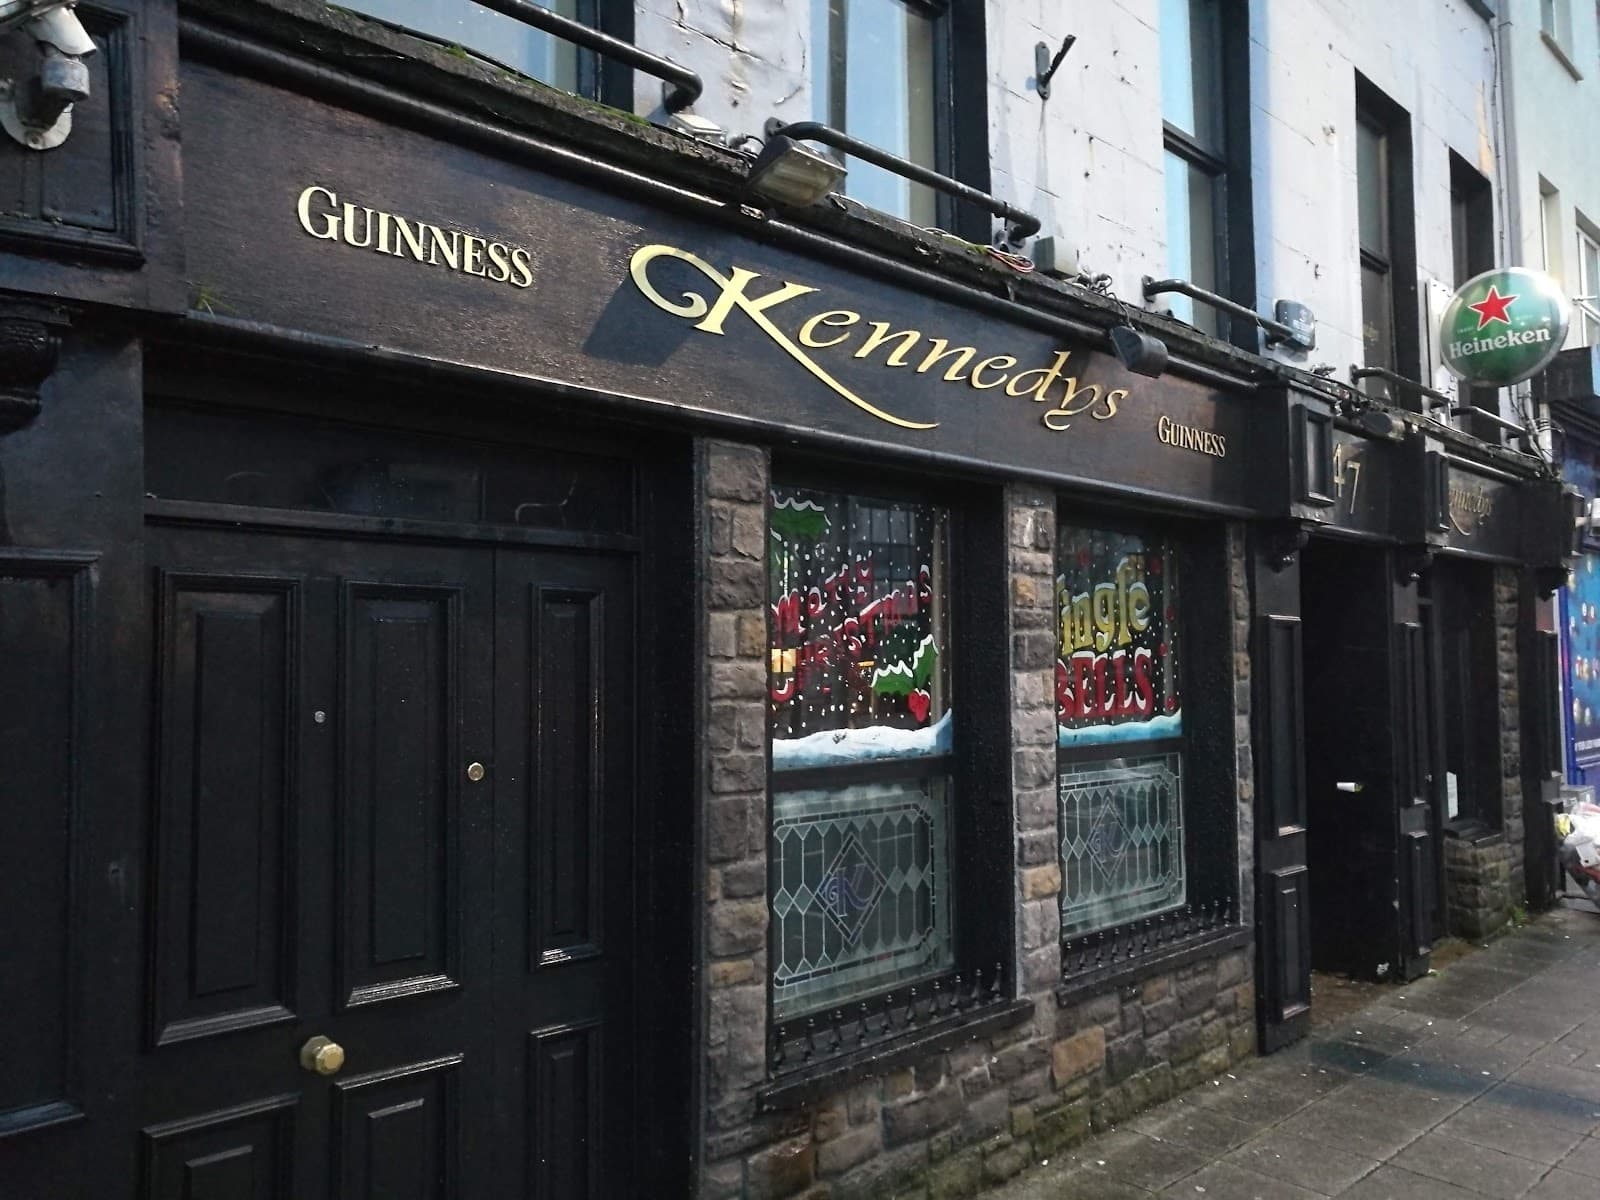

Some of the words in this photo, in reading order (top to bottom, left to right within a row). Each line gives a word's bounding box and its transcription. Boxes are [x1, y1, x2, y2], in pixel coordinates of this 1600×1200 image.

[296, 185, 534, 289] GUINNESS
[629, 243, 1130, 432] Kennedys
[1449, 327, 1552, 360] Heineken
[1157, 415, 1227, 458] GUINNESS
[1333, 443, 1361, 514] 47
